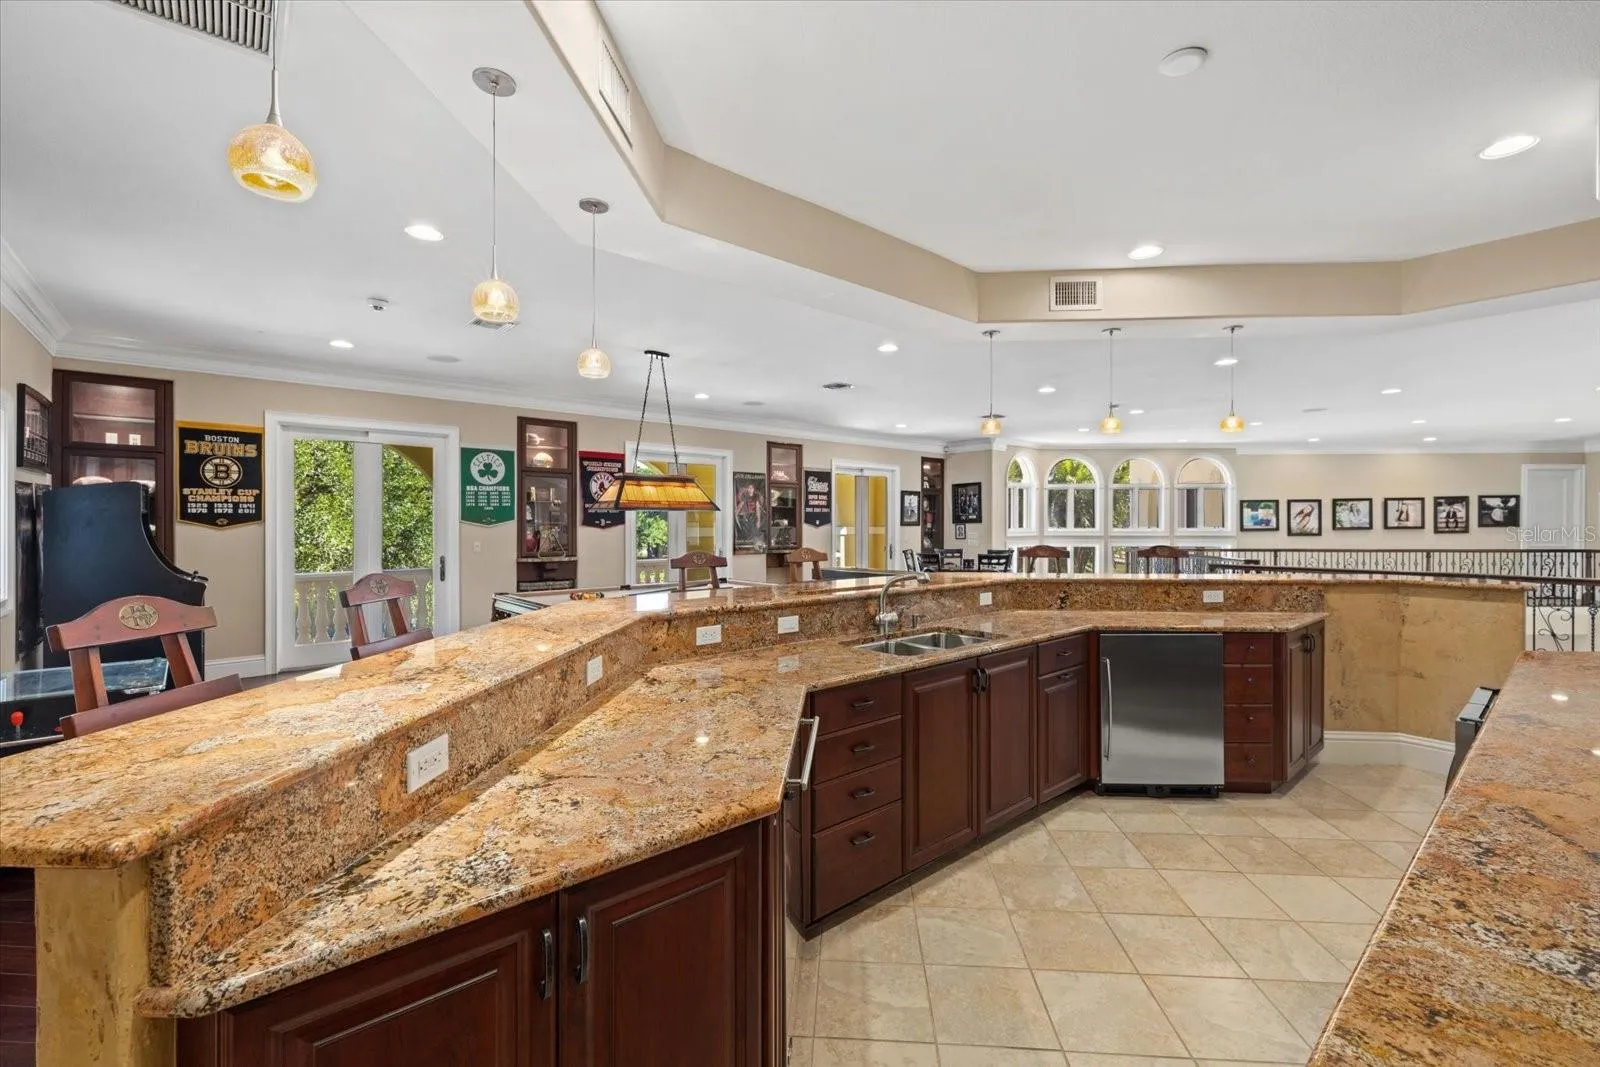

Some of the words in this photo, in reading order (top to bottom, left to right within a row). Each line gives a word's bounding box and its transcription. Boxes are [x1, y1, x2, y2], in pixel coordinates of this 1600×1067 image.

[204, 434, 240, 443] BOSTON
[183, 440, 258, 458] BRUINS
[214, 463, 231, 480] B
[182, 487, 233, 495] STANLEY
[237, 488, 260, 496] CUP
[187, 495, 255, 503] CHAMPIONS
